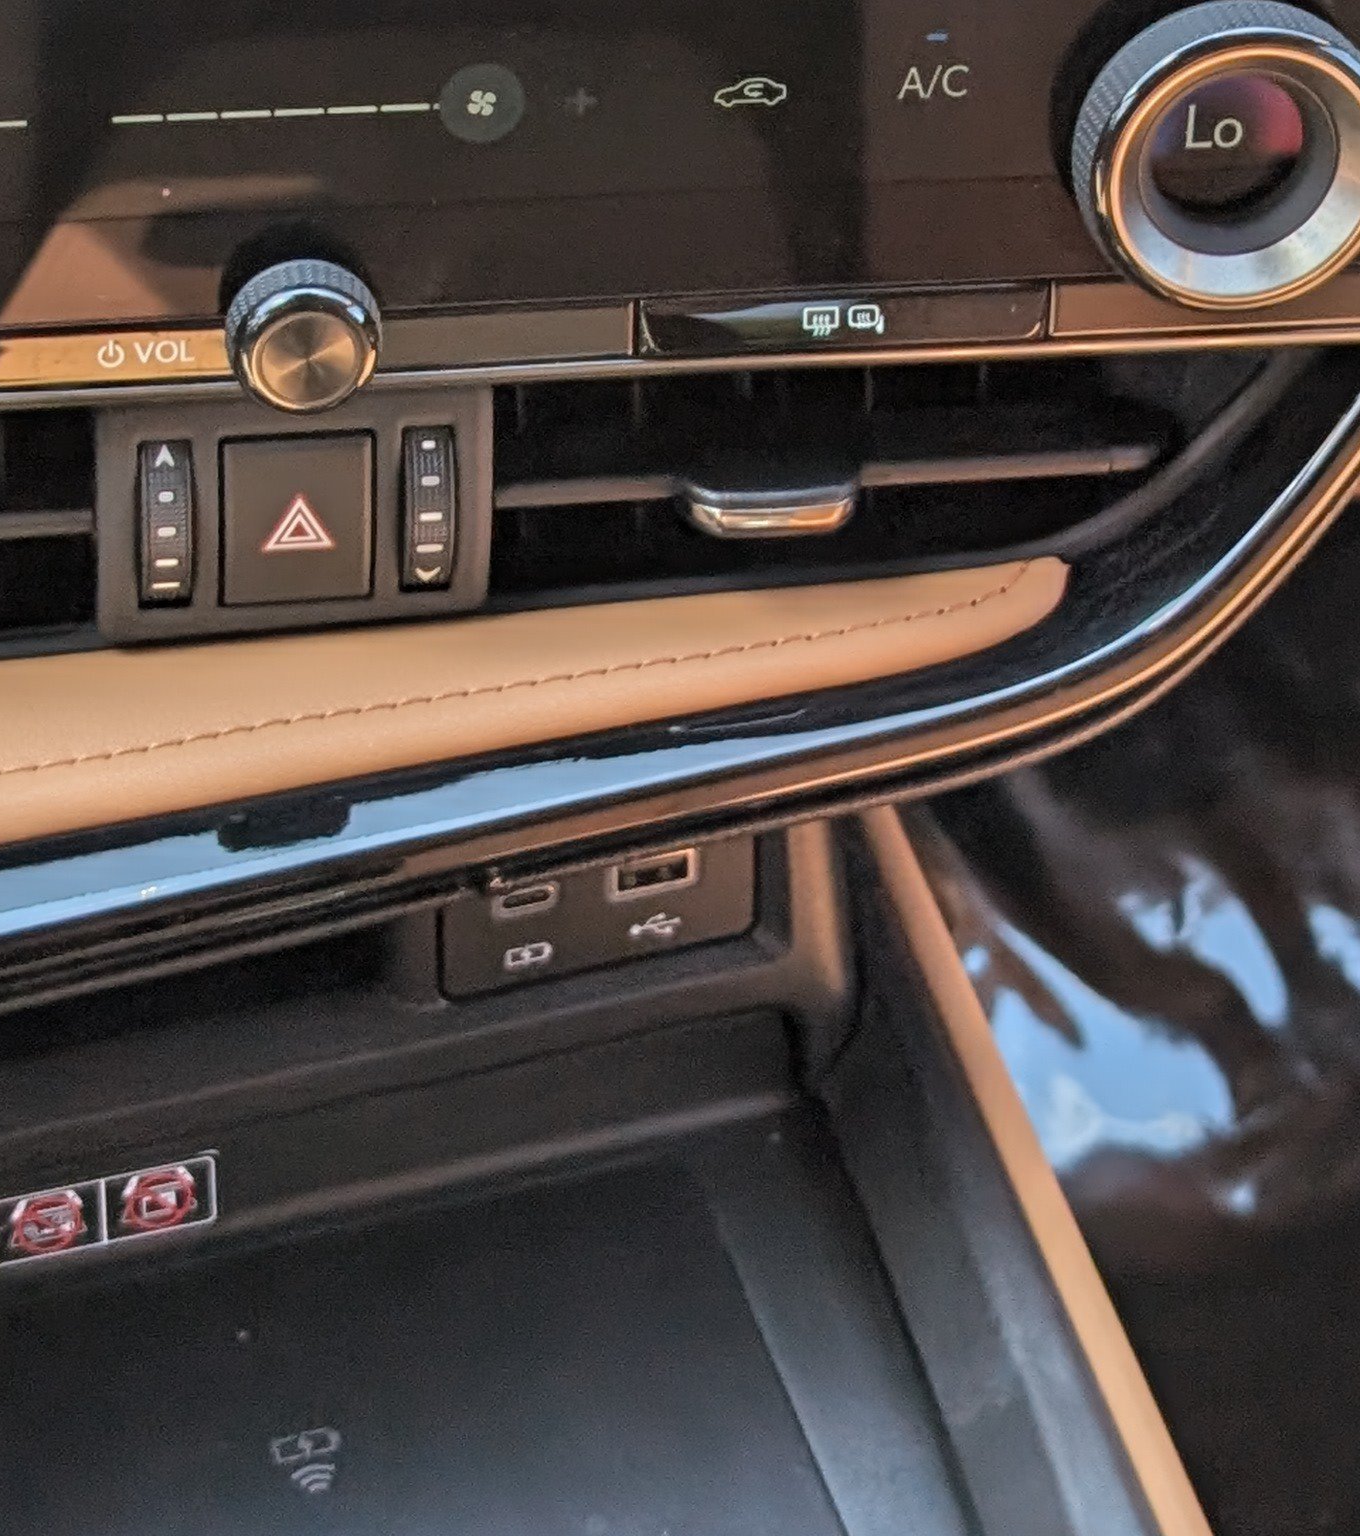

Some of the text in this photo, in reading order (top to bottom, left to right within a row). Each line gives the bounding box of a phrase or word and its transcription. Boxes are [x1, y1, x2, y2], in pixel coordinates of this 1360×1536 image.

[897, 64, 969, 102] A/C
[1184, 104, 1244, 151] Lo
[133, 338, 196, 366] VOL
